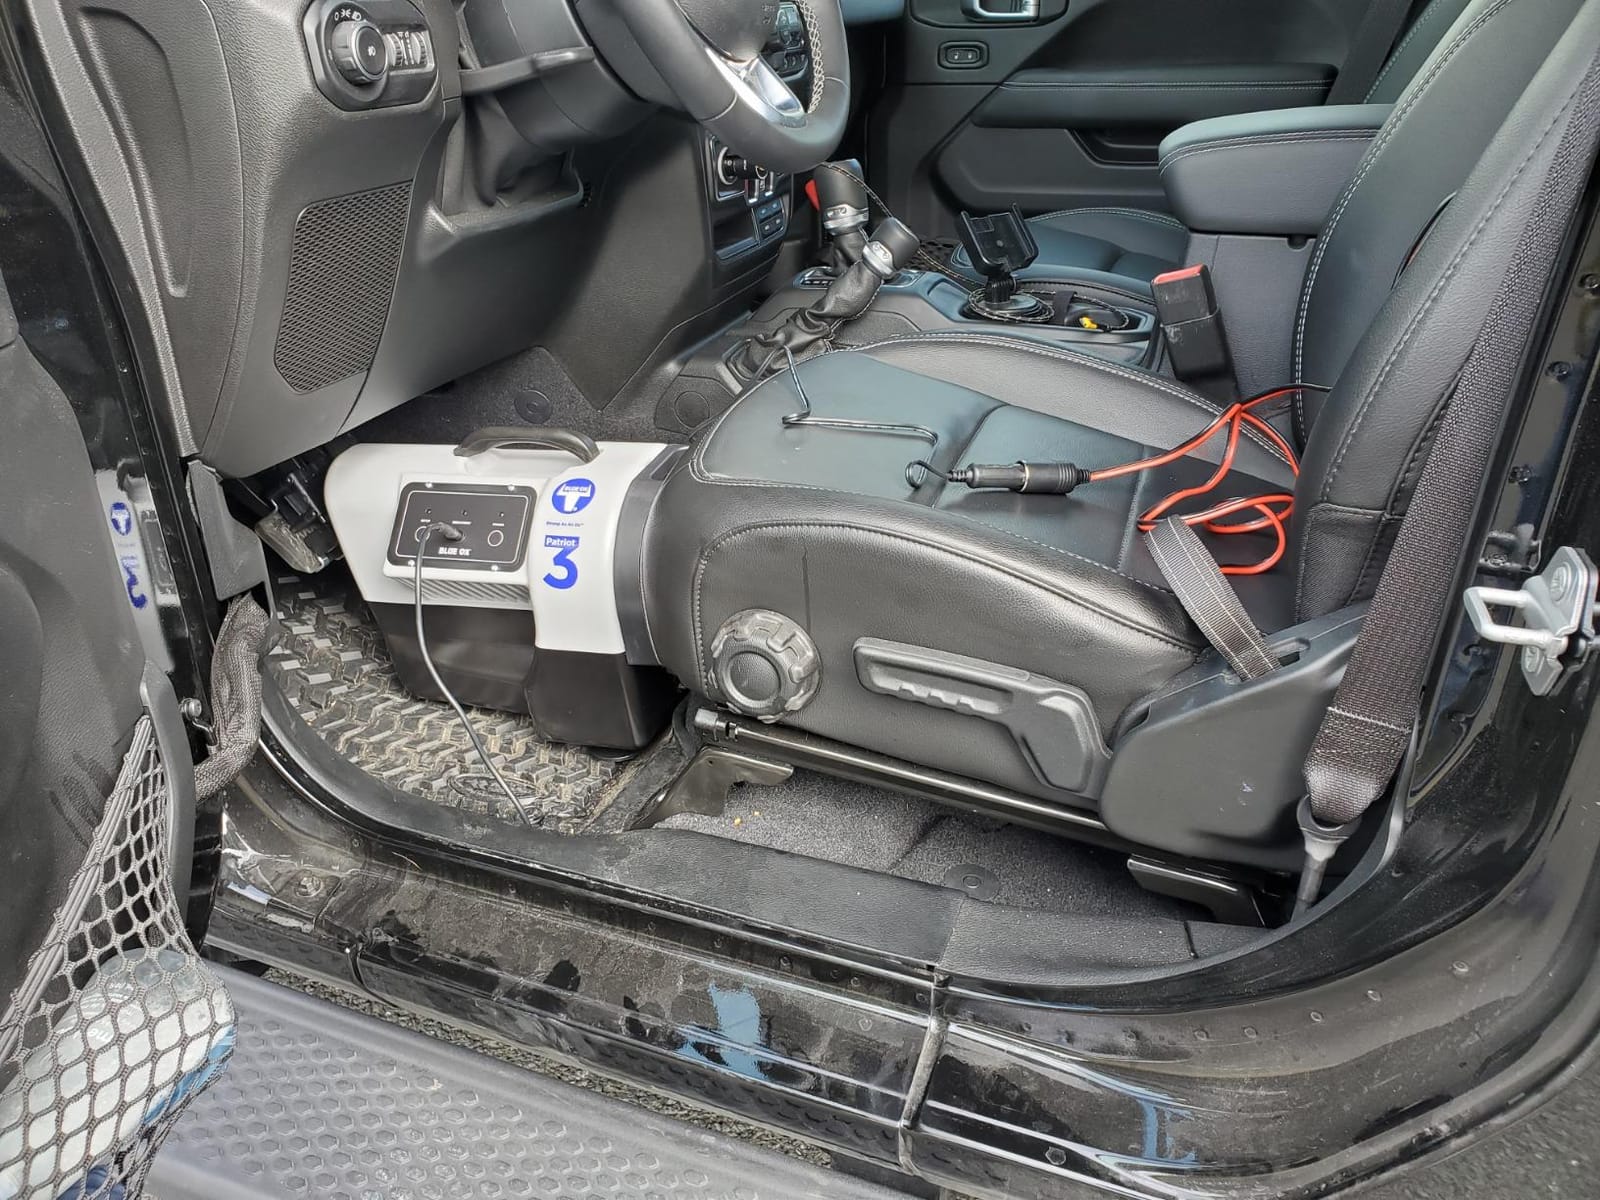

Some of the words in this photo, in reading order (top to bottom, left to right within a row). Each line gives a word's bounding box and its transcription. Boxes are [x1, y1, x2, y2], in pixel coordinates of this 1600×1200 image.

[546, 537, 576, 547] Patriot
[438, 546, 458, 555] BLUE
[543, 546, 578, 589] 3
